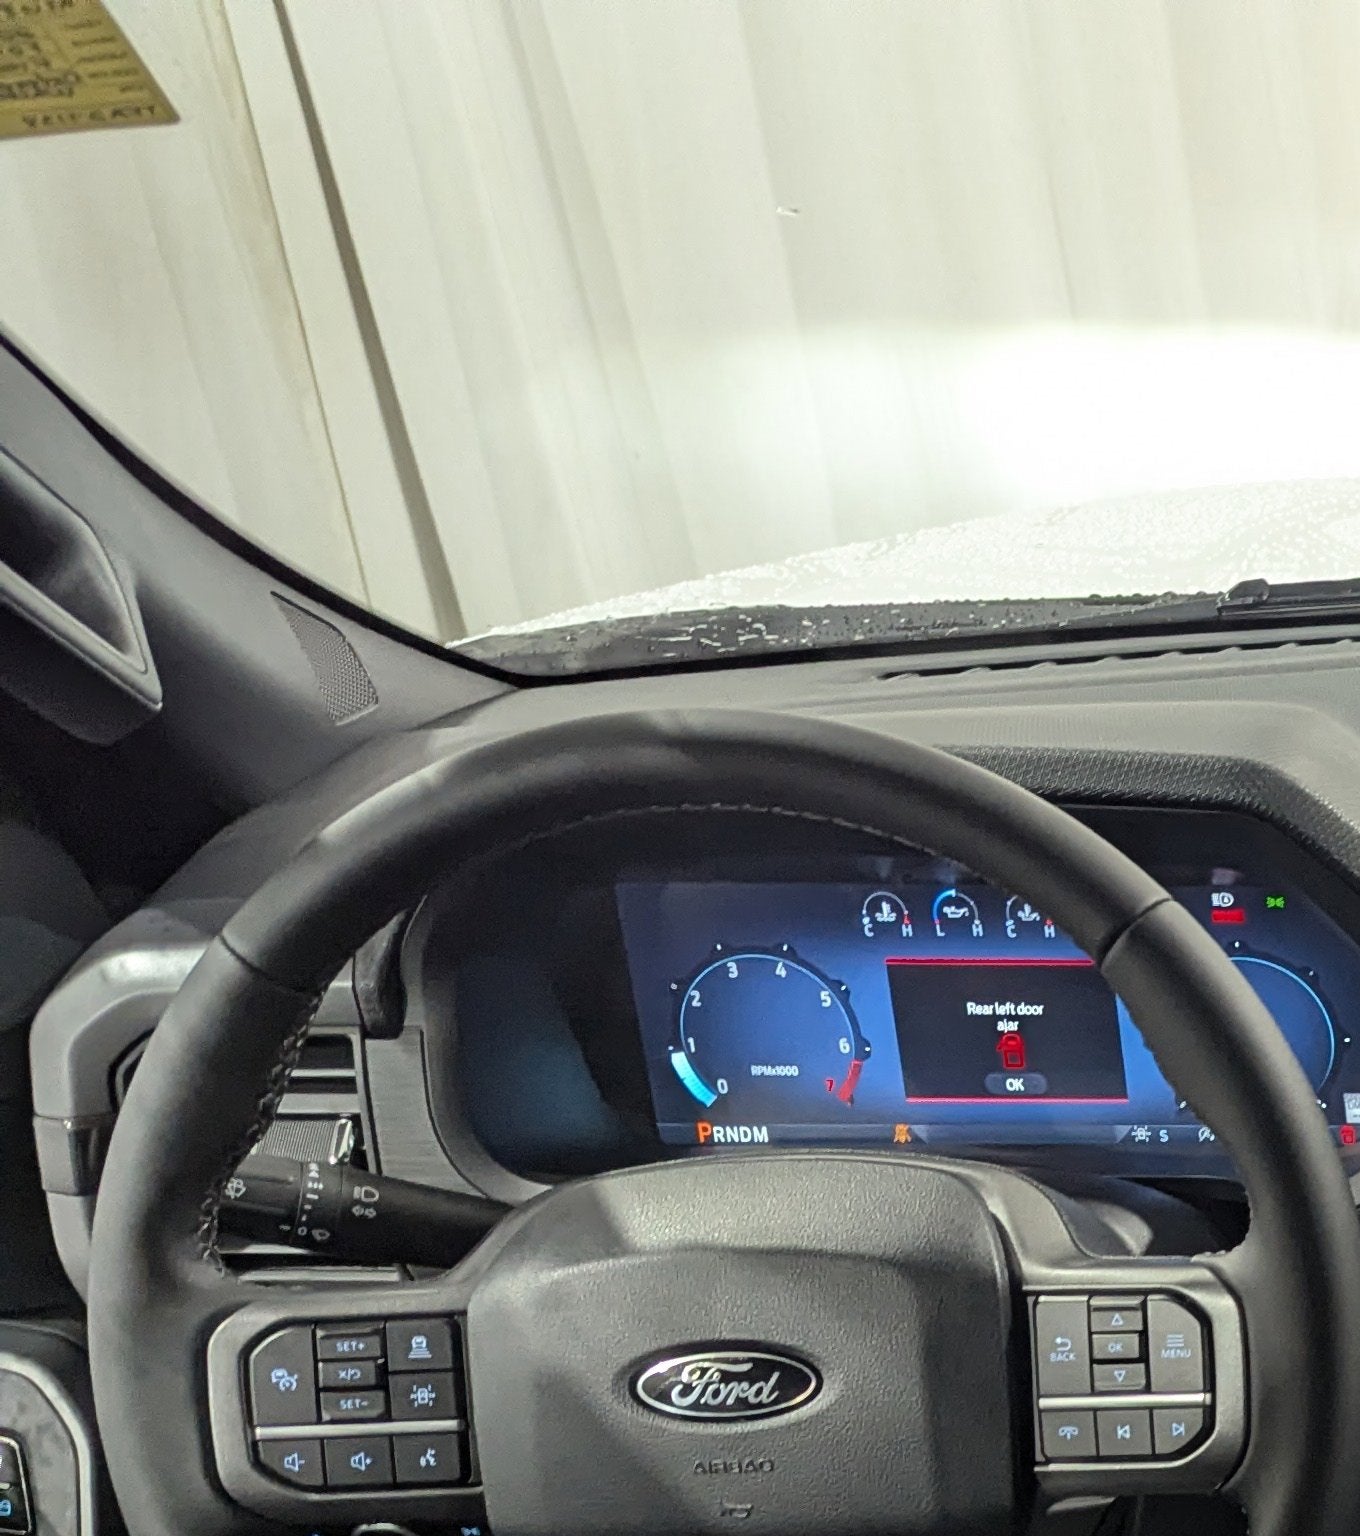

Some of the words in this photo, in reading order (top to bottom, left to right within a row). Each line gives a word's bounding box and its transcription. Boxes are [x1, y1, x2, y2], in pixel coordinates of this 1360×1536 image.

[864, 924, 874, 938] C
[902, 924, 913, 938] H
[936, 924, 945, 938] L
[972, 924, 983, 938] H
[1044, 924, 1056, 938] H
[727, 962, 738, 979] 3
[775, 962, 787, 979] 4
[690, 991, 702, 1008] 2
[820, 991, 832, 1008] 5
[966, 1001, 994, 1016] Rear
[995, 1001, 1016, 1016] left
[1016, 1001, 1044, 1016] door
[997, 1018, 1019, 1034] ajar
[687, 1037, 696, 1053] 1
[838, 1037, 850, 1054] 6
[717, 1079, 728, 1095] 0
[825, 1079, 835, 1092] 7
[1005, 1077, 1025, 1092] OK
[1159, 1129, 1169, 1143] S
[1108, 1342, 1123, 1353] OK
[1161, 1349, 1192, 1359] MENU
[1050, 1352, 1076, 1362] BACK
[665, 1361, 780, 1407] Ford
